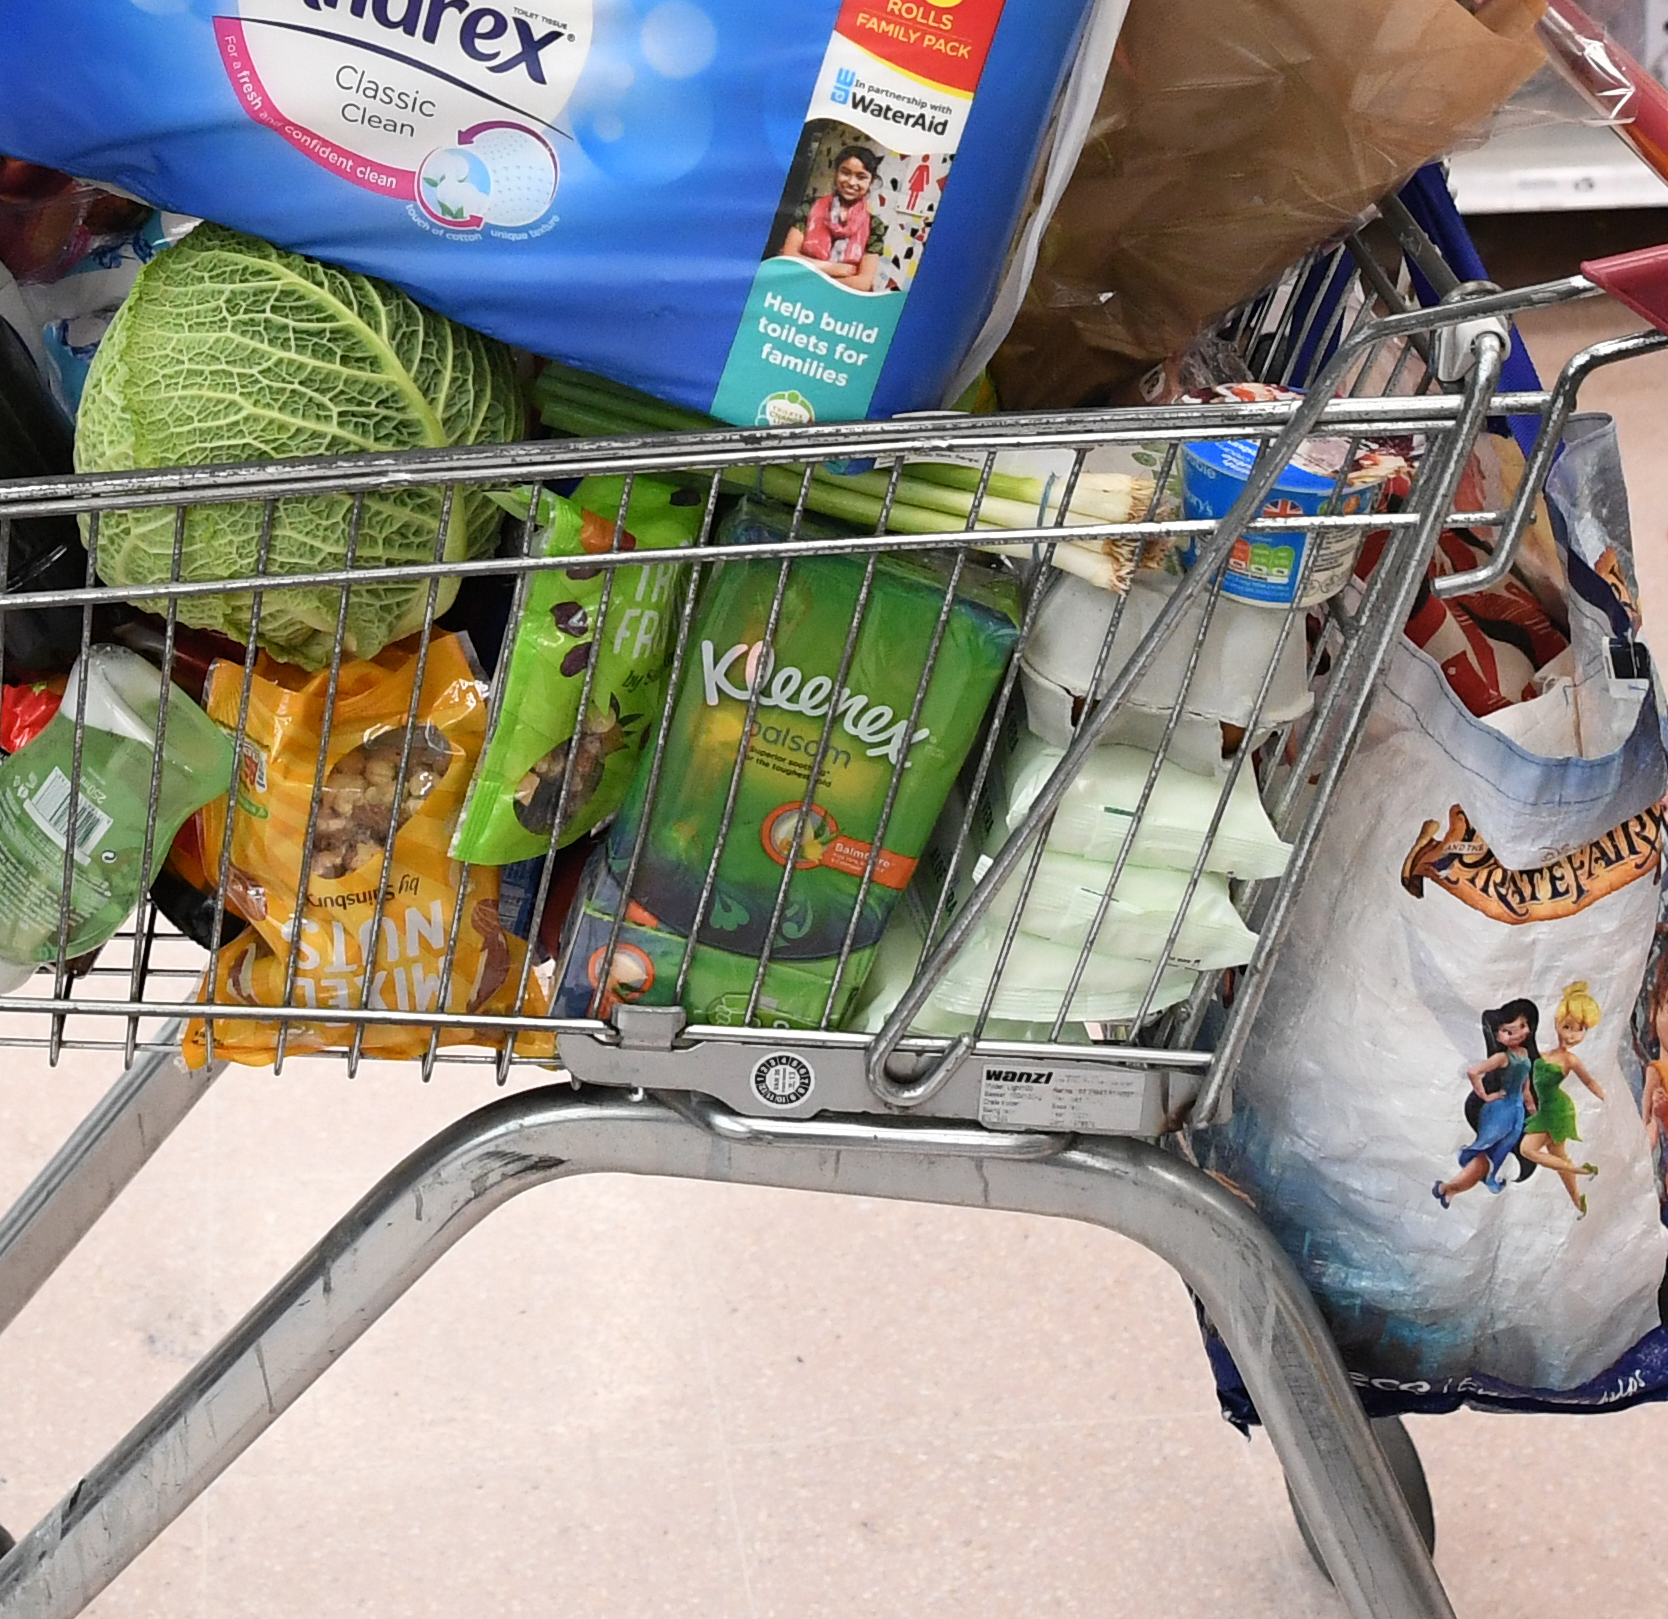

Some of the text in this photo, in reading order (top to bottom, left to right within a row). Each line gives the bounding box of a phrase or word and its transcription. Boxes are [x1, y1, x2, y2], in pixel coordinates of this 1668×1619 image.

[513, 6, 568, 30] TOILET TISSUE
[855, 12, 973, 60] FAMILY PACK
[224, 34, 238, 58] For
[236, 69, 263, 112] fresh
[259, 110, 283, 128] and
[283, 124, 355, 173] confident
[355, 164, 397, 190] clean
[335, 64, 437, 118] Classic
[854, 78, 953, 115] In partnership with
[340, 102, 416, 138] Clean
[850, 91, 950, 137] WaterAid
[405, 203, 483, 243] touch of cotton
[490, 214, 561, 242] unique texture
[763, 290, 879, 345] Help build
[757, 316, 869, 367] toilets for
[760, 342, 849, 387] families
[701, 639, 931, 769] Kleenex
[755, 756, 771, 769] the
[395, 873, 421, 896] by
[280, 899, 445, 973] NUTS
[984, 1068, 1054, 1085] wanzl
